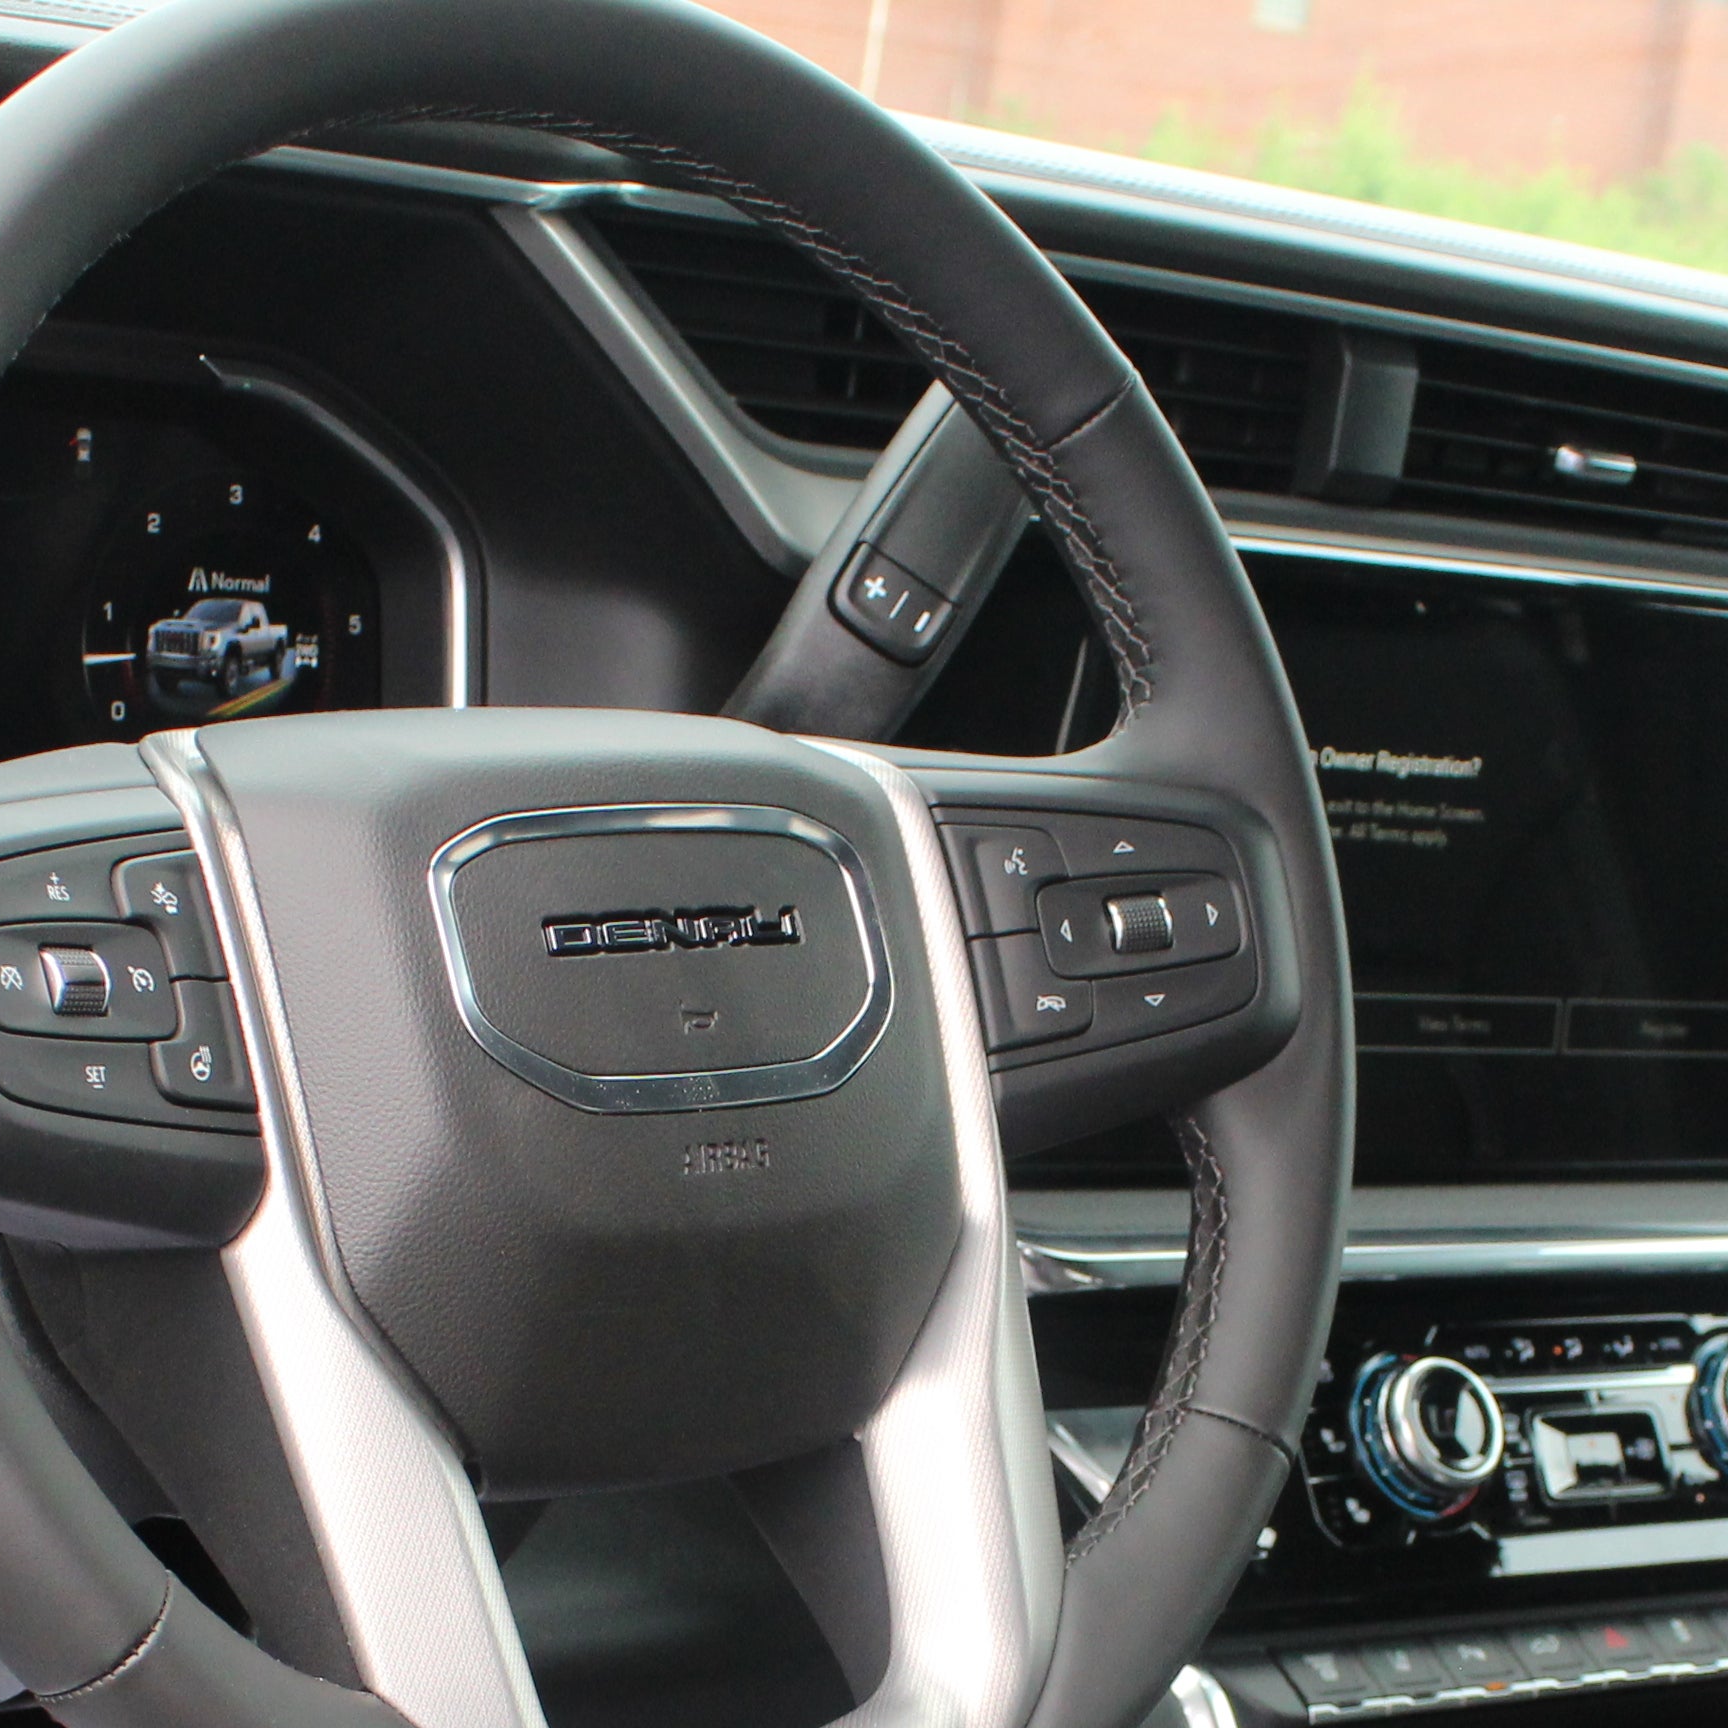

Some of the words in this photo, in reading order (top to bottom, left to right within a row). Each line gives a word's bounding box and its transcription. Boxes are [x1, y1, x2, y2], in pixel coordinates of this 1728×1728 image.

[229, 485, 243, 504] 3
[147, 513, 161, 533] 2
[308, 525, 321, 543] 4
[211, 571, 271, 592] Normal
[103, 602, 114, 622] 1
[348, 614, 362, 635] 5
[111, 702, 125, 722] 0
[1320, 746, 1375, 771] Owner
[46, 885, 70, 901] RES
[541, 905, 803, 957] DENALI
[85, 1065, 106, 1083] SET
[684, 1138, 771, 1175] AIRBAG
